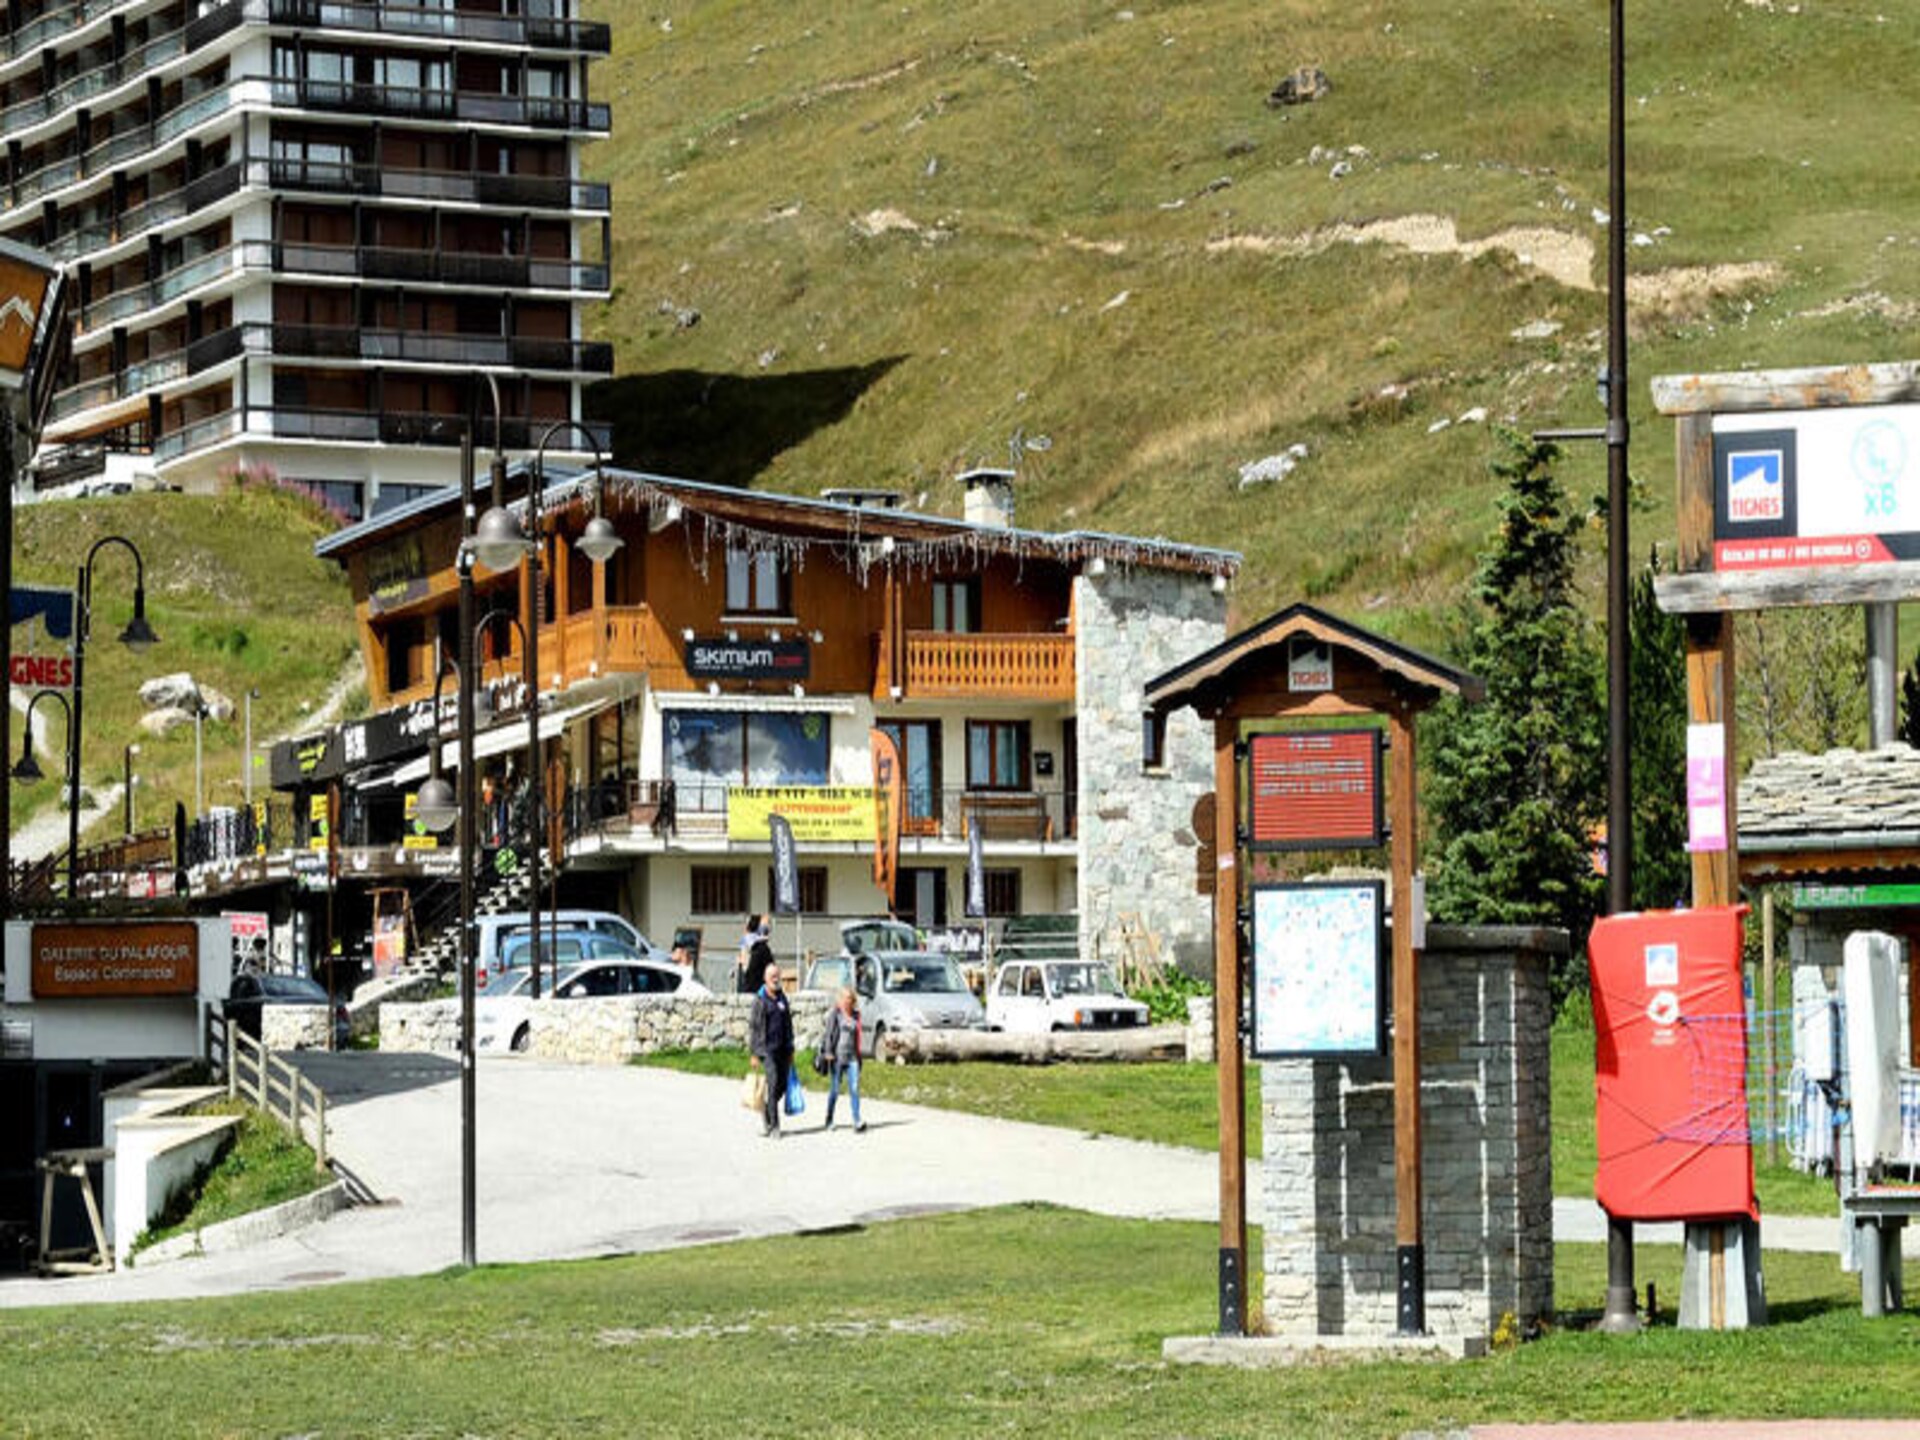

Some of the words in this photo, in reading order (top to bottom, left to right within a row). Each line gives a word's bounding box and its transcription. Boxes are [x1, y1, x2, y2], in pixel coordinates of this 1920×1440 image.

[1732, 498, 1779, 517] TIGNES
[10, 655, 73, 687] GNES
[40, 946, 97, 962] GALERIE
[100, 946, 118, 961] DU
[121, 944, 190, 961] PALAFOUR
[54, 965, 97, 982] Espace
[102, 964, 175, 980] Commercial
